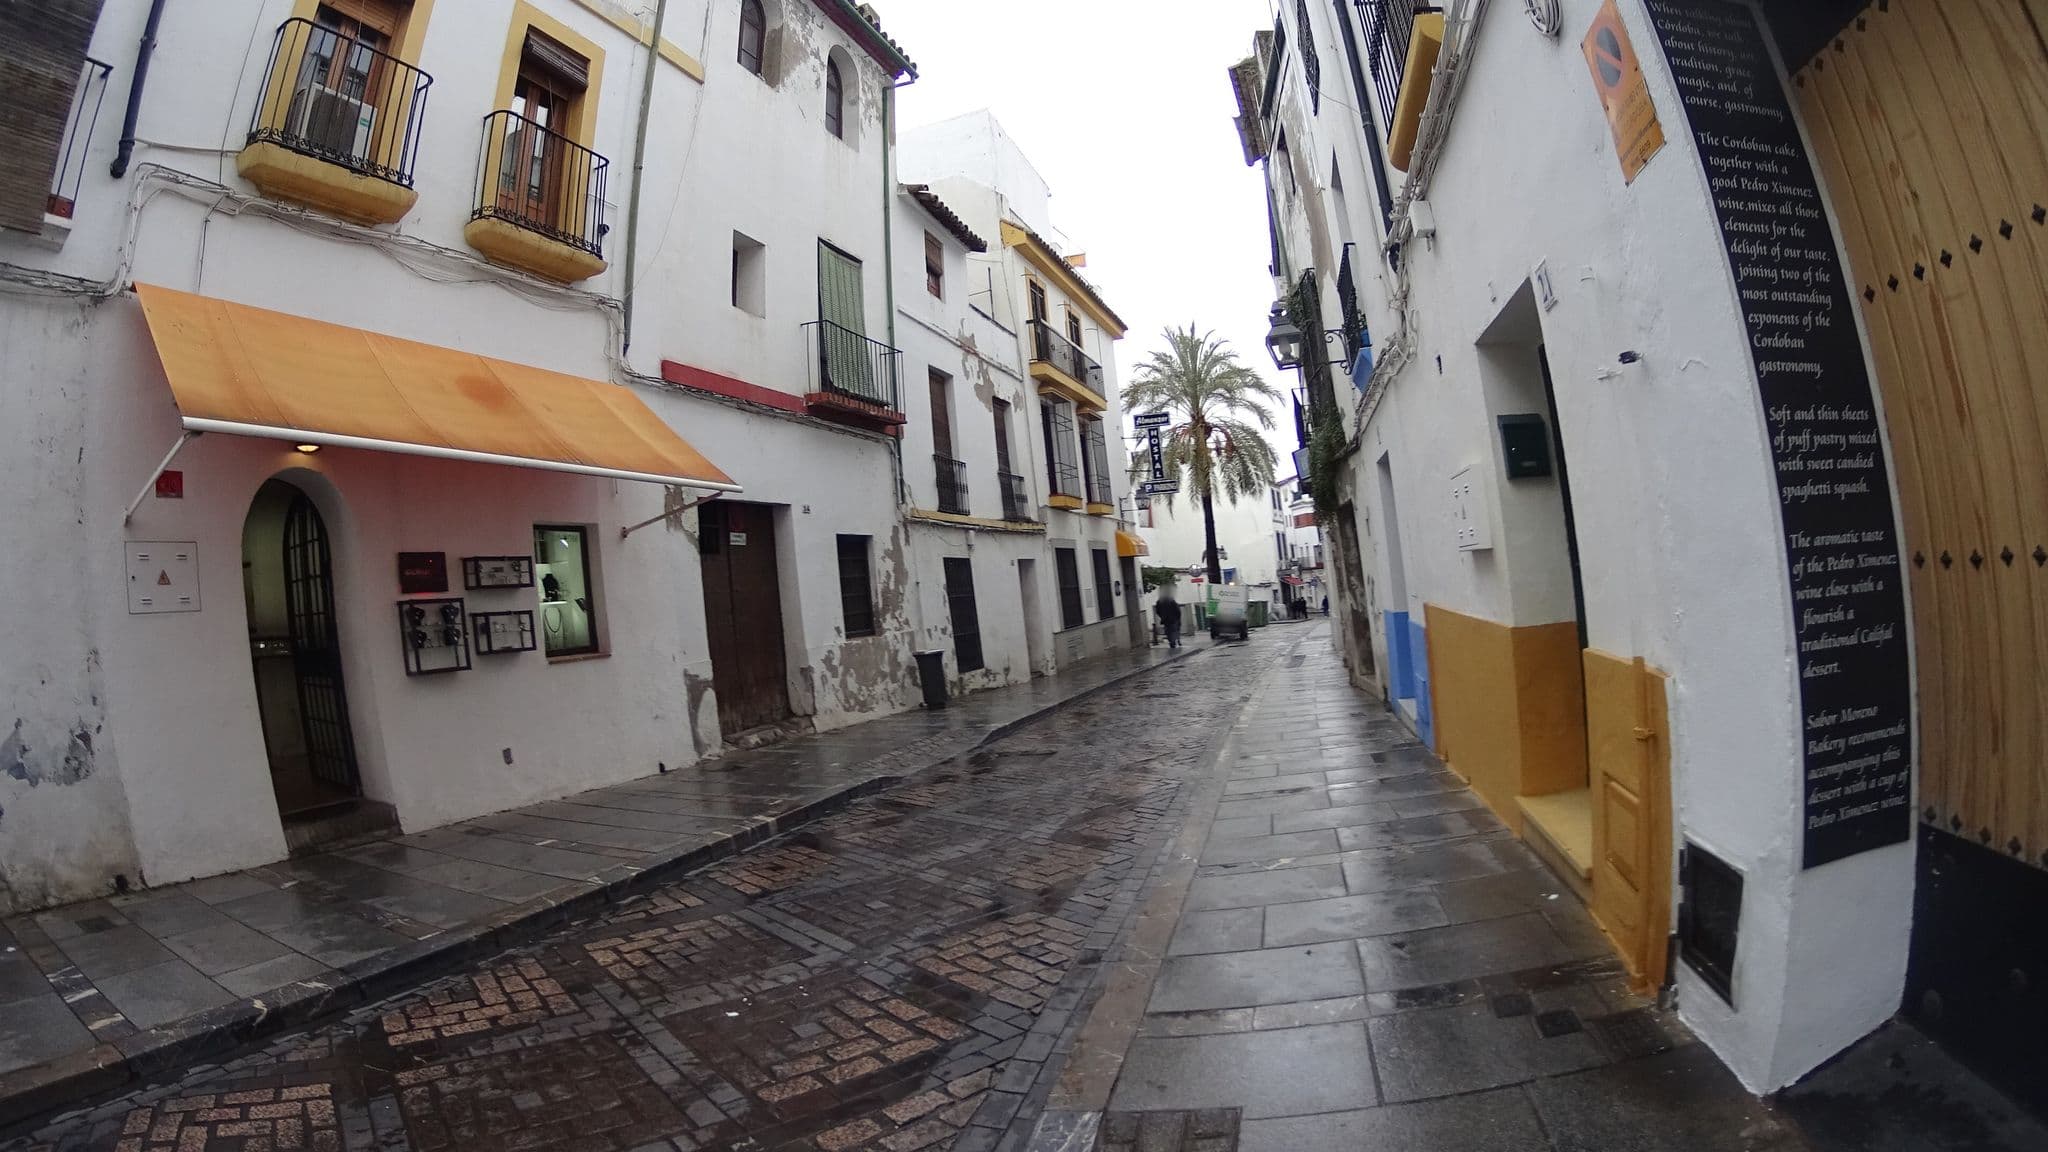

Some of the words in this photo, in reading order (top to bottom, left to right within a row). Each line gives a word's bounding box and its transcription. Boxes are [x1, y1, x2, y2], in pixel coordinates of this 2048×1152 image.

[1648, 0, 1682, 15] When
[1664, 36, 1695, 50] about
[1744, 83, 1753, 99] of
[1698, 131, 1719, 146] The
[1722, 136, 1772, 153] Cordoban
[1709, 155, 1752, 172] together
[1755, 160, 1779, 174] with
[1781, 166, 1788, 175] a
[1712, 175, 1738, 192] good
[1741, 176, 1769, 191] Pedro
[1772, 181, 1814, 198] Ximenez
[1779, 202, 1792, 215] all
[1795, 203, 1819, 219] those
[1724, 216, 1770, 235] elements
[1770, 220, 1788, 240] for
[1790, 222, 1805, 238] the
[1731, 238, 1767, 260] delight
[1770, 242, 1781, 262] of
[1784, 247, 1801, 258] our
[1737, 263, 1778, 284] joining
[1781, 268, 1800, 281] two
[1803, 266, 1813, 287] of
[1815, 267, 1830, 283] the
[1742, 288, 1768, 301] most
[1771, 288, 1832, 310] outstanding
[1748, 312, 1800, 329] exponents
[1802, 311, 1813, 331] of
[1815, 311, 1830, 327] the
[1753, 331, 1805, 348] Cordoban
[1769, 404, 1791, 428] Soft
[1794, 404, 1815, 421] and
[1817, 404, 1839, 420] thin
[1841, 404, 1869, 421] sheets
[1774, 428, 1785, 453] of
[1785, 428, 1812, 453] puff
[1811, 434, 1846, 452] pastry
[1849, 428, 1878, 445] mixed
[1150, 429, 1162, 478] HOSTAL
[1778, 454, 1804, 472] with
[1806, 458, 1834, 470] sweet
[1837, 452, 1875, 469] candied
[1145, 484, 1153, 493] P
[1782, 478, 1831, 504] spaghetti
[1789, 531, 1811, 550] The
[1813, 529, 1860, 547] aromatic
[1862, 530, 1885, 543] taste
[1793, 556, 1806, 582] of
[1807, 555, 1825, 573] the
[1827, 552, 1855, 572] Pedro
[1796, 585, 1823, 600] wine
[1825, 579, 1849, 597] close
[1851, 575, 1875, 593] with
[1876, 580, 1884, 591] a
[1799, 604, 1845, 634] flourish
[1846, 608, 1855, 620] a
[1801, 627, 1860, 652] traditional
[1808, 734, 1846, 756] Bakery
